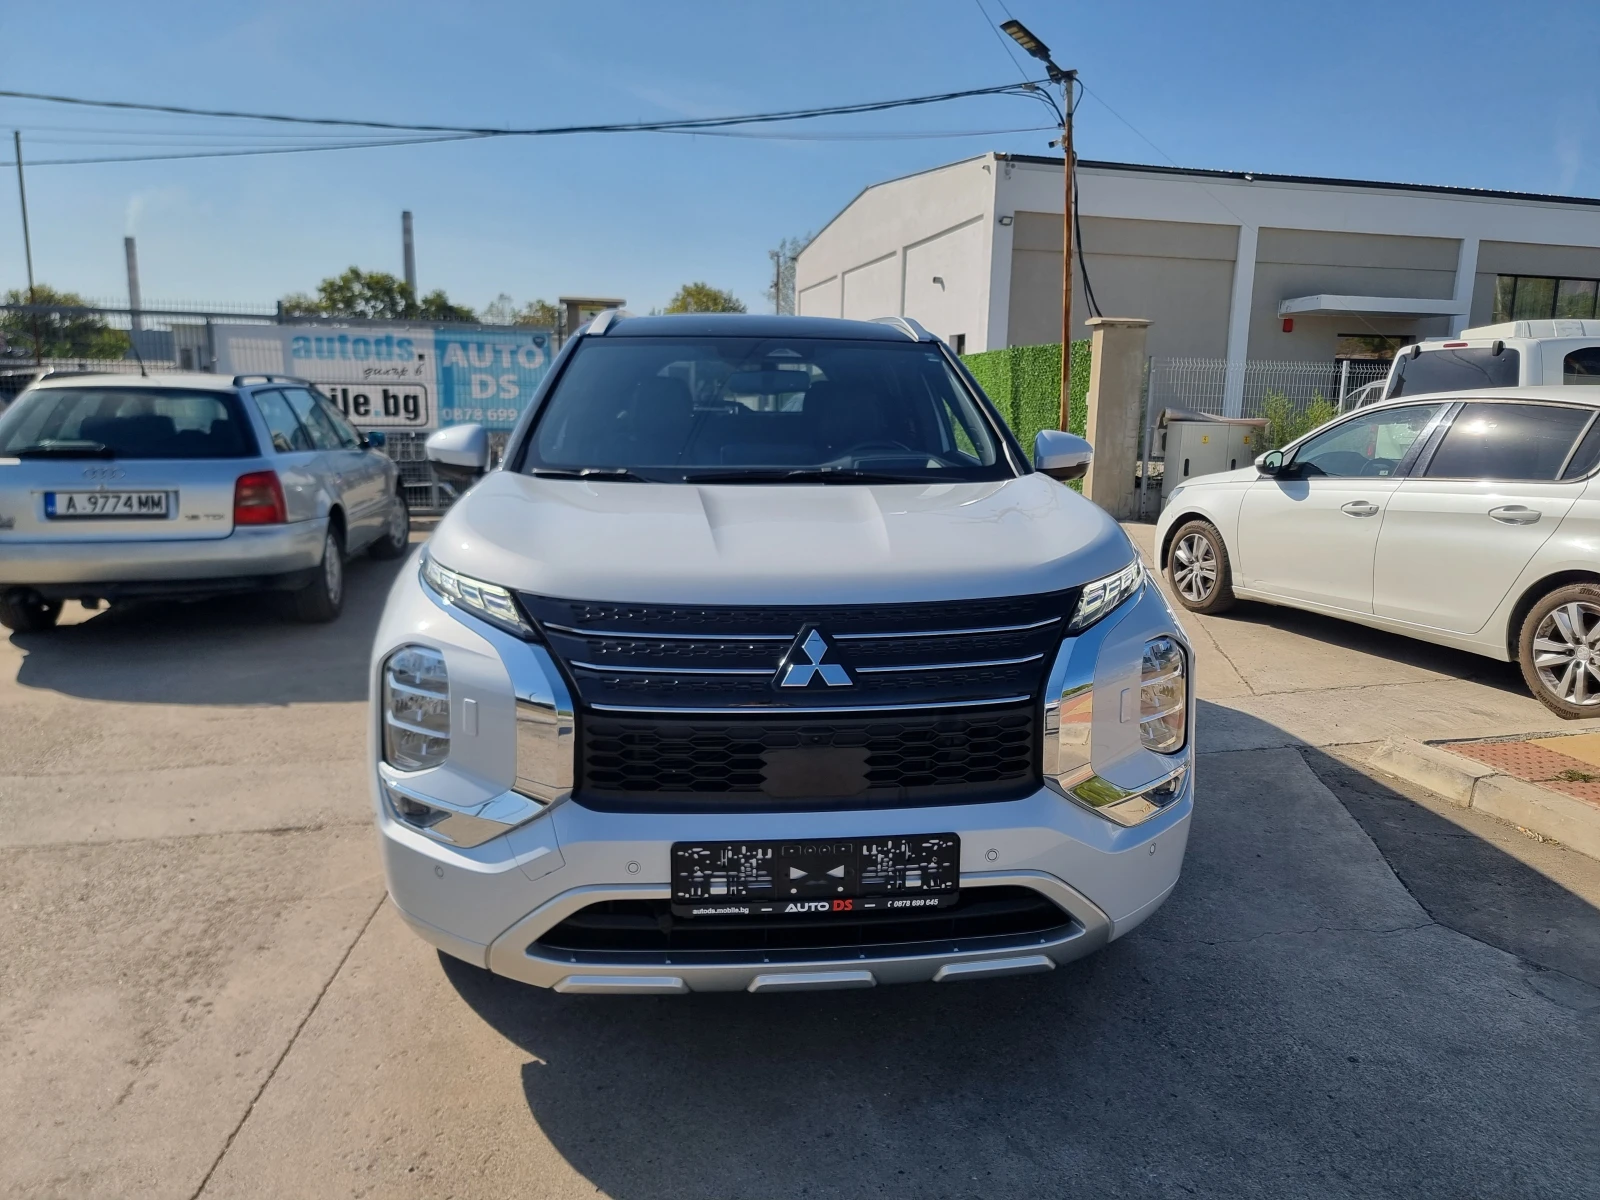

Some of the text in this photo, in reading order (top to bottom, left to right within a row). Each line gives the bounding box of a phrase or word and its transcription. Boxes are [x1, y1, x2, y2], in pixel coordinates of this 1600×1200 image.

[443, 342, 545, 369] AUTO
[471, 373, 519, 399] DS
[443, 408, 518, 421] 0878 699
[692, 906, 749, 915] autods.mobile.bg
[784, 902, 829, 913] AUTO
[833, 900, 853, 911] DS
[894, 900, 910, 908] 0878
[912, 899, 924, 907] 699
